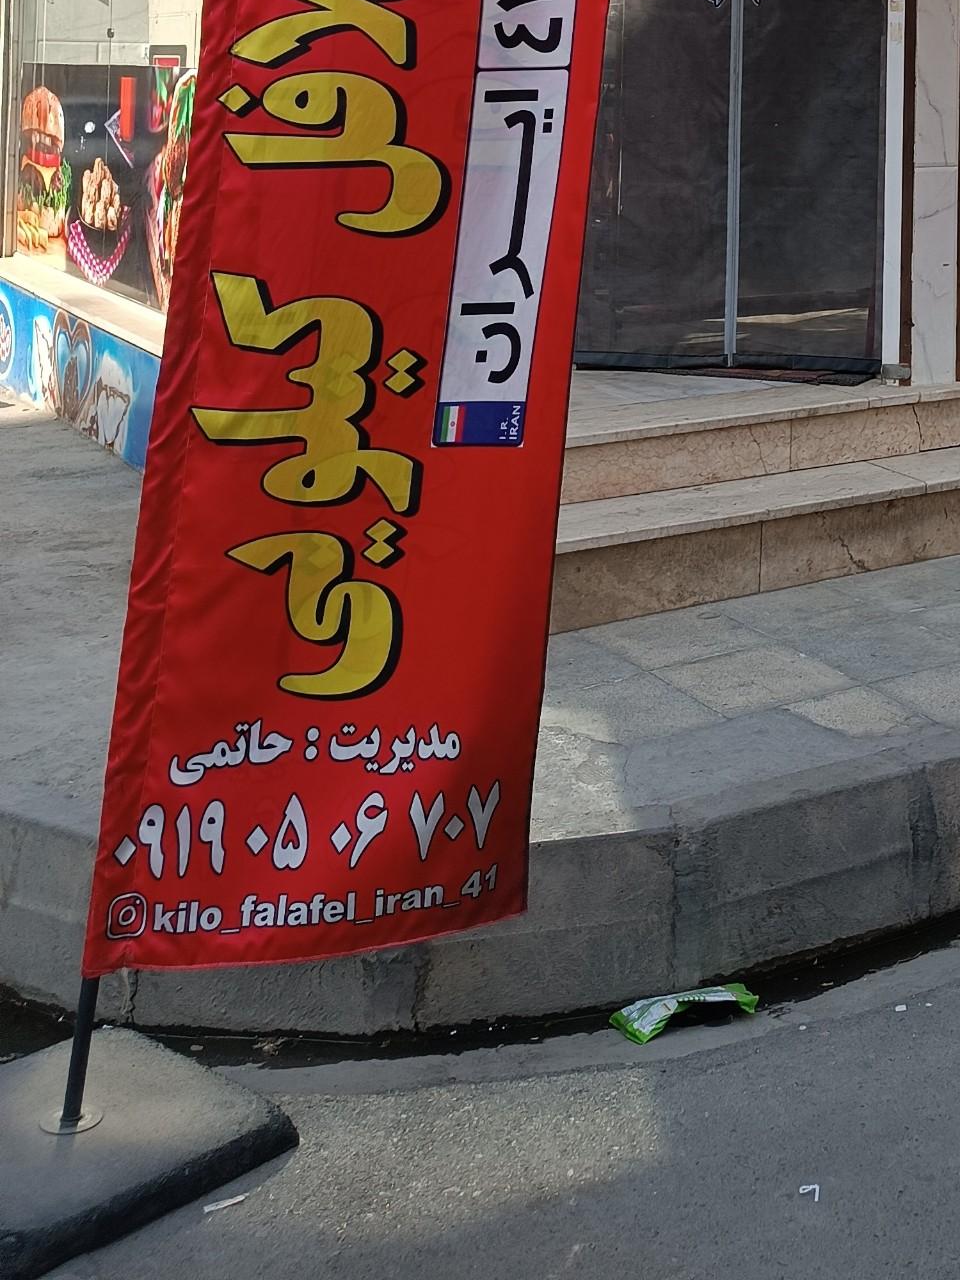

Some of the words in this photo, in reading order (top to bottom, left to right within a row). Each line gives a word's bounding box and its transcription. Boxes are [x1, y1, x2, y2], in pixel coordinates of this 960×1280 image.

[459, 87, 555, 385] ایران
[508, 405, 521, 440] IRAN
[190, 270, 428, 701] کیلویی
[168, 718, 294, 786] حاتمی
[328, 721, 462, 775] مدیریت
[113, 798, 227, 881] ۰۹۱۹
[245, 792, 309, 871] ۰۵
[408, 779, 501, 862] ۷۰۷
[152, 863, 500, 936] kilo_falafel_iran_41
